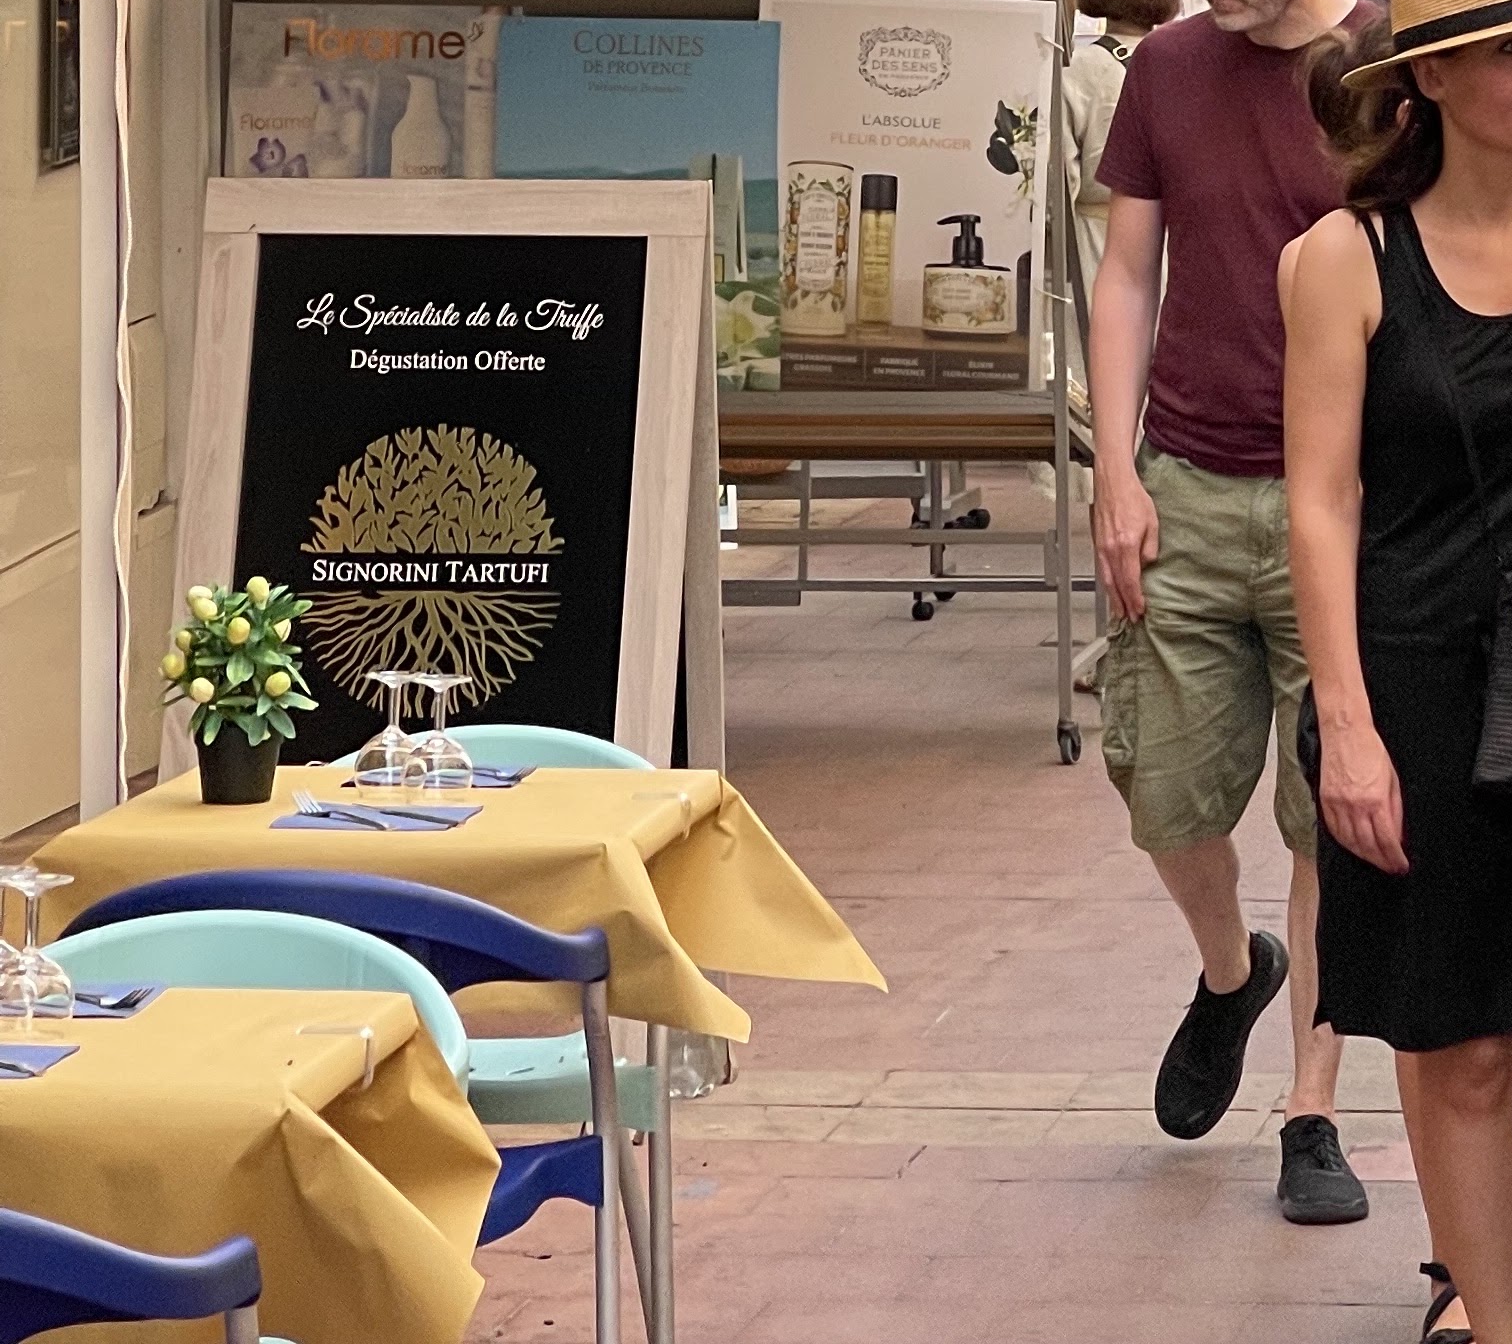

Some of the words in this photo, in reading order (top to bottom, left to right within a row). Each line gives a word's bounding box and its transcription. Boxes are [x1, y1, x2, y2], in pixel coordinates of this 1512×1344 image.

[284, 18, 465, 60] Florame
[574, 30, 704, 57] COLLINES
[880, 47, 931, 60] PANIER
[583, 60, 604, 74] DE
[607, 61, 692, 76] PROVENCE
[872, 60, 899, 72] DES
[901, 61, 938, 73] SENS
[862, 115, 941, 129] L'ABSOLUE
[830, 132, 877, 146] FLEUR
[881, 135, 972, 151] D'ORANGER
[296, 293, 335, 335] Le
[340, 294, 461, 335] Spécialiste
[466, 302, 491, 327] de
[496, 302, 518, 327] la
[523, 298, 604, 341] Truffe
[350, 349, 468, 374] Dégustation
[474, 350, 546, 371] Offerte
[312, 559, 437, 583] SIGNORINI
[445, 561, 549, 583] TARTUFI
